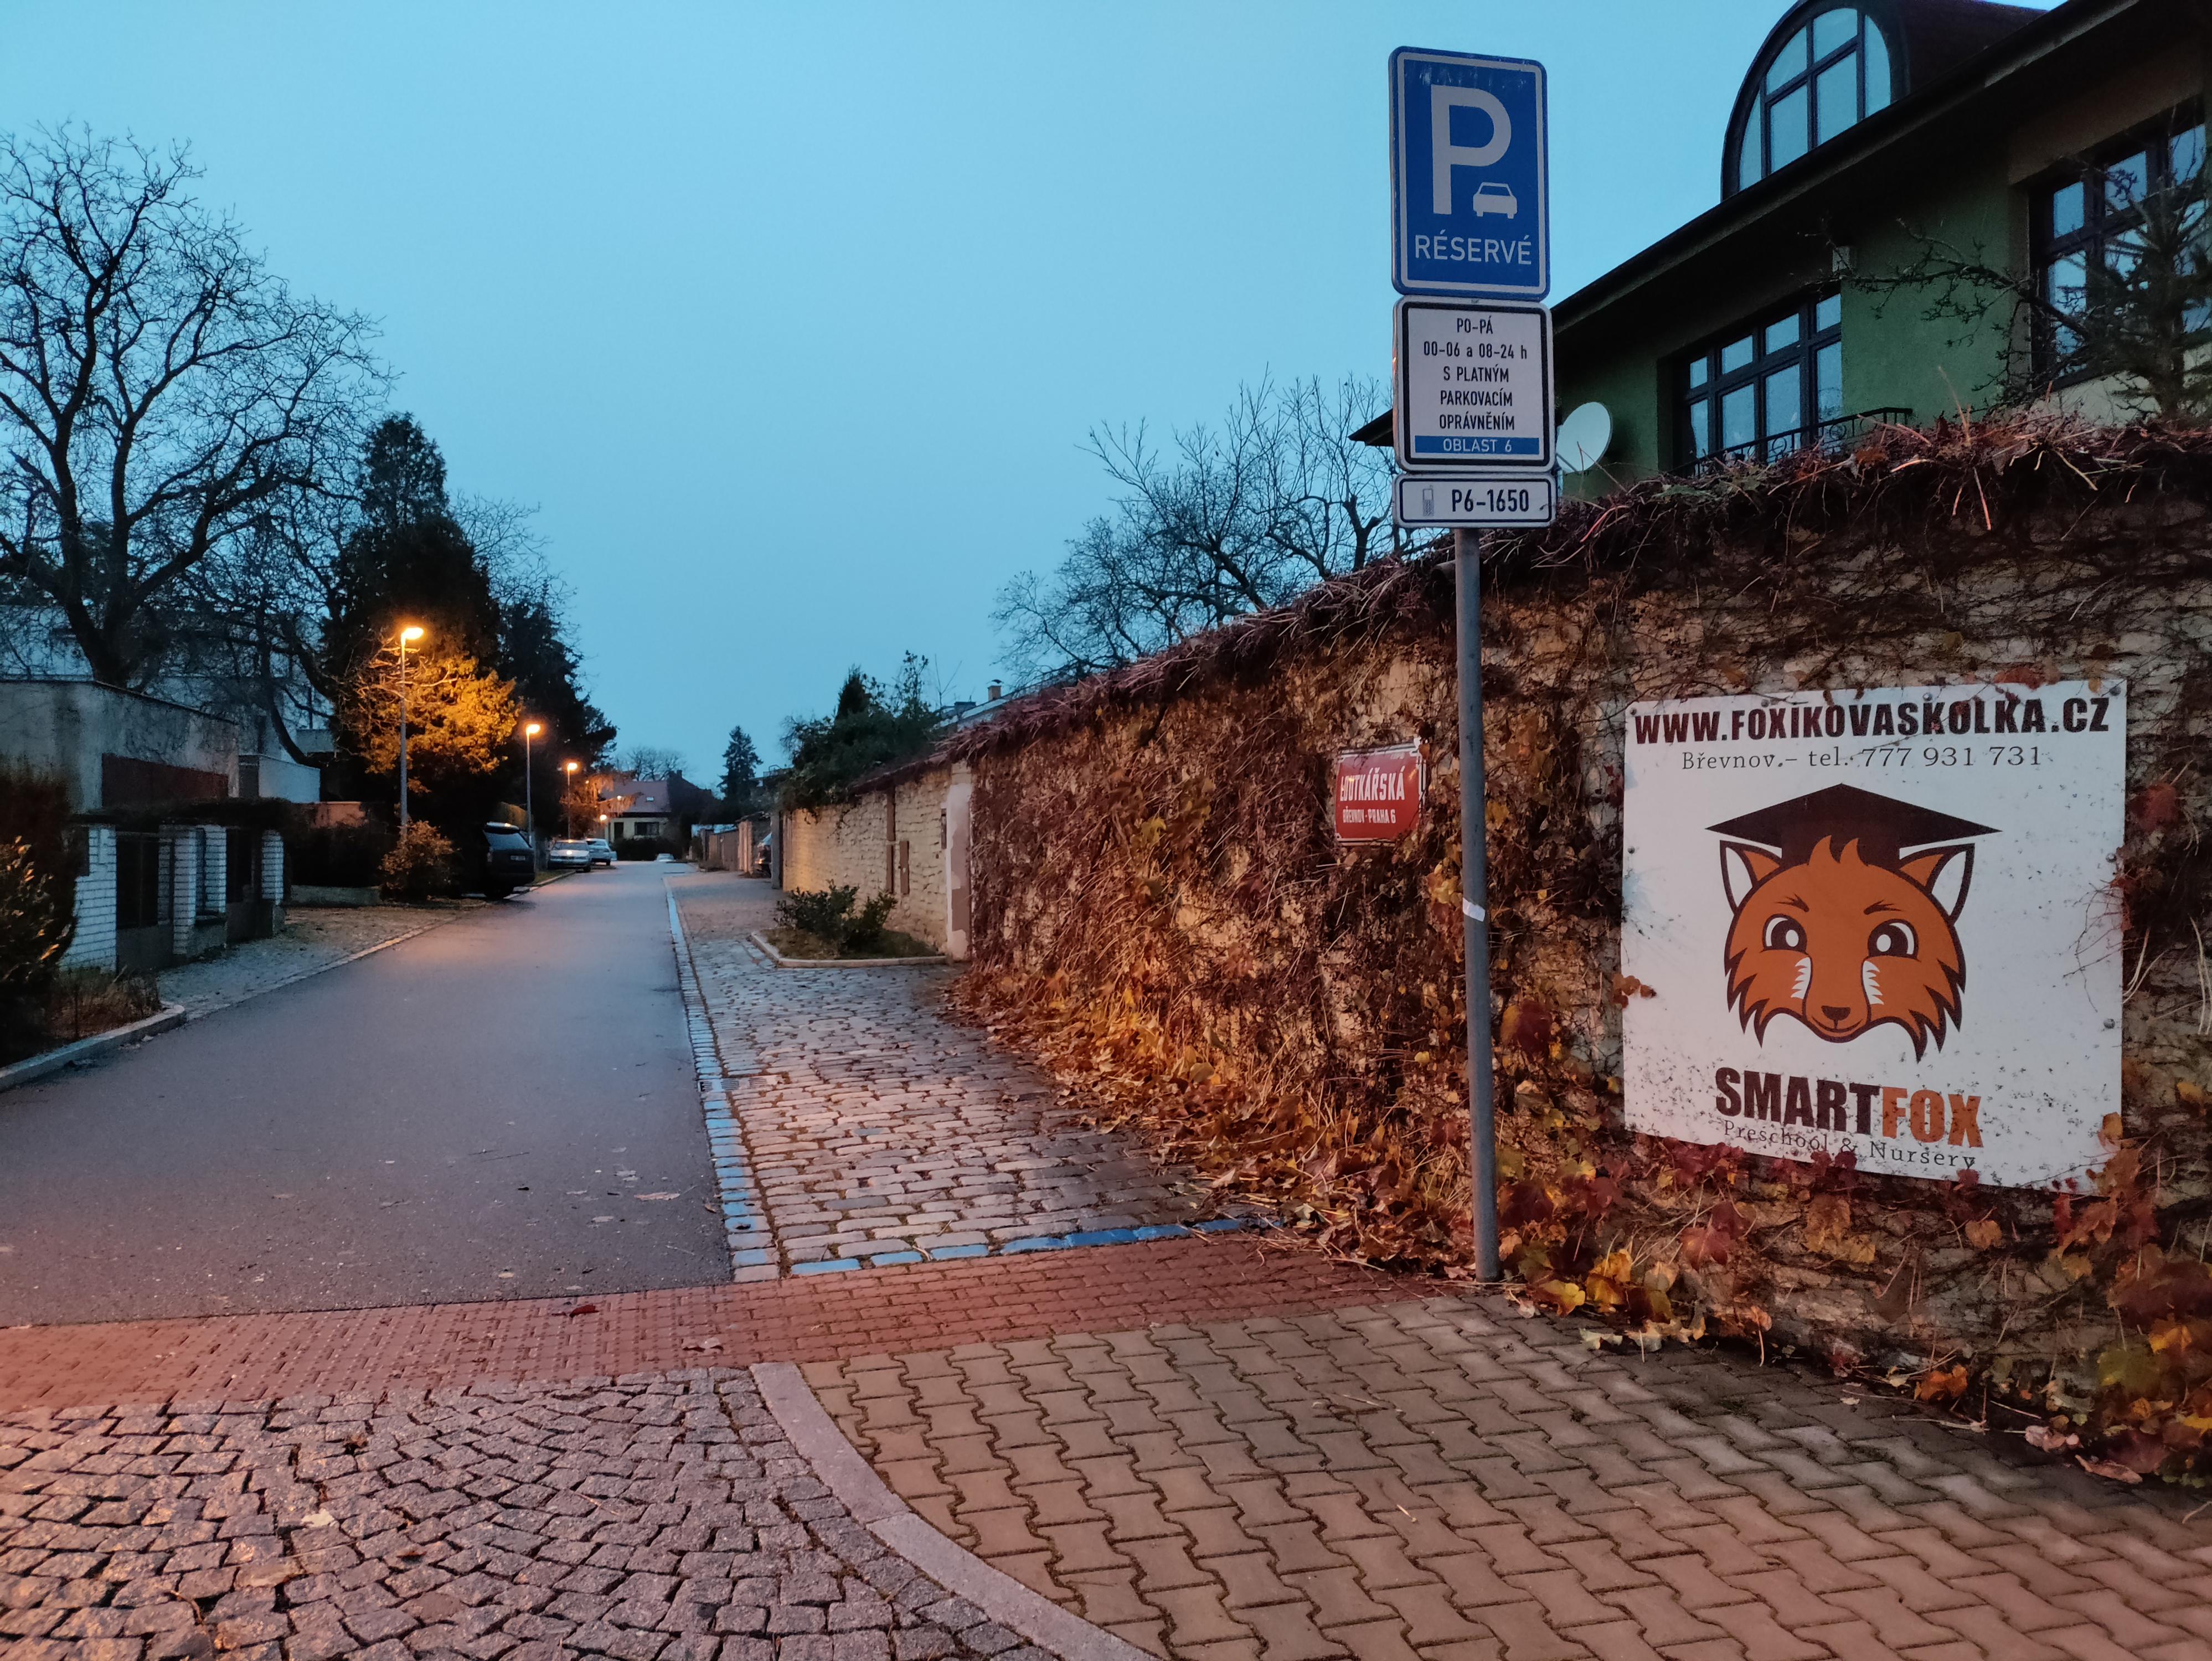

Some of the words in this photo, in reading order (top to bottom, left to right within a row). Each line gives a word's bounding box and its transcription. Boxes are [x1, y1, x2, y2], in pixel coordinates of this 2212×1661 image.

[1431, 84, 1512, 215] P
[1415, 229, 1532, 265] RÉSERVÉ
[1457, 316, 1493, 334] PO-PÁ
[1424, 341, 1460, 357] 00-06
[1466, 348, 1473, 358] a
[1479, 343, 1514, 359] 08-24
[1521, 345, 1527, 359] h
[1443, 366, 1451, 381] S
[1457, 364, 1509, 383] PLATNÝM
[1440, 388, 1513, 407] PARKOVACÍM
[1439, 411, 1515, 431] OPRÁVNĚNÍM
[1443, 438, 1497, 453] OBLAST
[1505, 441, 1512, 453] 6
[1452, 489, 1529, 513] P6-1650
[1635, 698, 2110, 744] WWW.FOXIKOVASKOLKA.CZ
[1808, 746, 1849, 767] tel.
[1862, 747, 1913, 767] 777
[1923, 747, 1974, 766] 931
[1989, 746, 2042, 766] 731
[1390, 809, 1396, 824] 6
[1724, 1120, 1828, 1152] Preschool
[1840, 1138, 1857, 1154] &
[1869, 1142, 1976, 1169] Nursery
